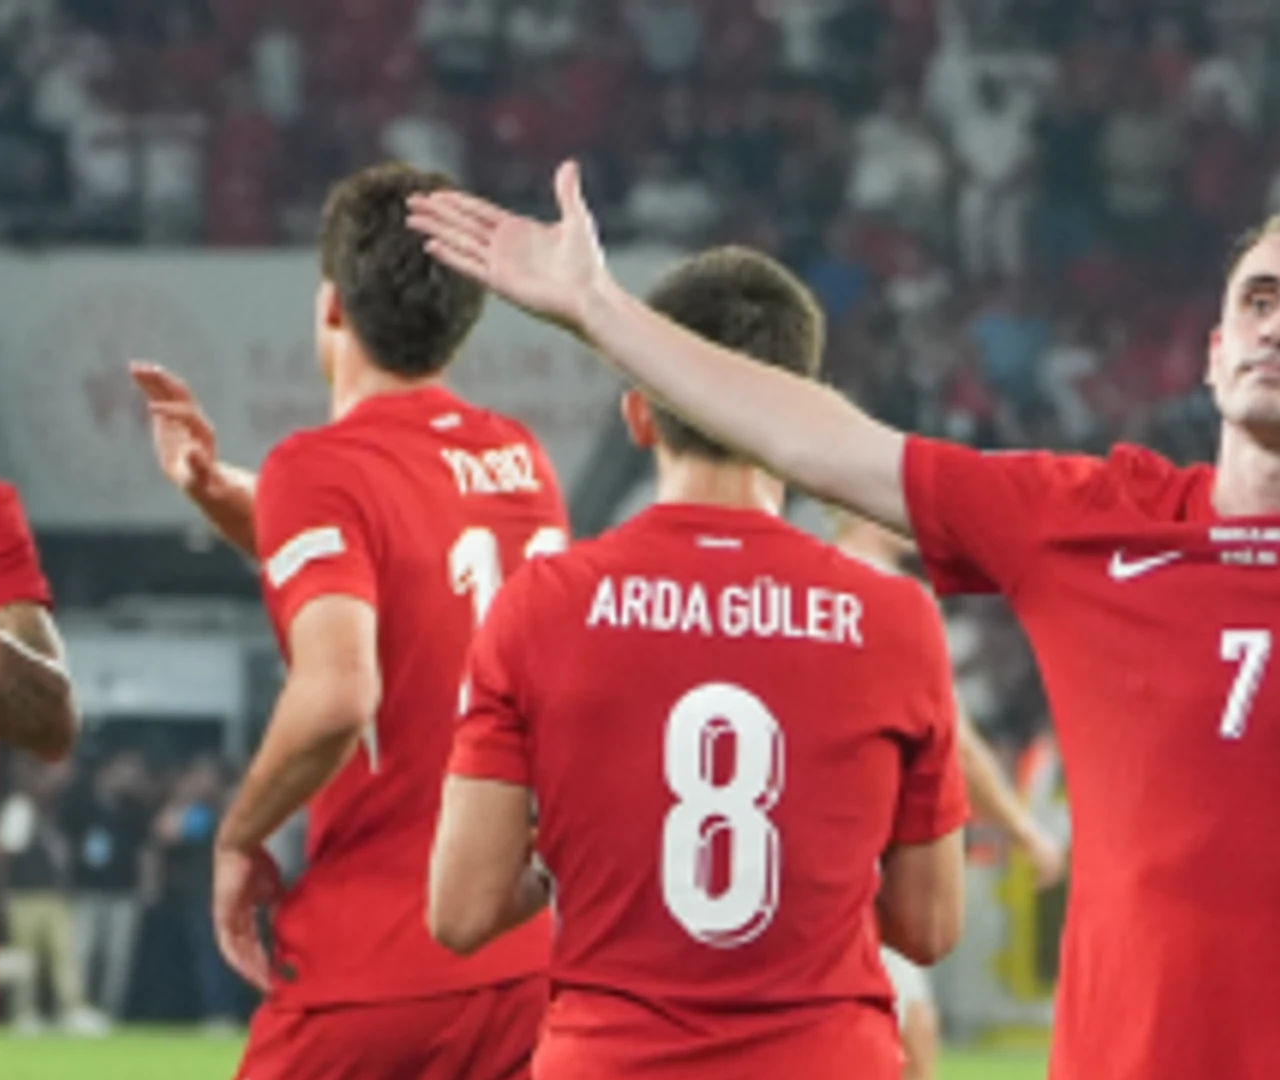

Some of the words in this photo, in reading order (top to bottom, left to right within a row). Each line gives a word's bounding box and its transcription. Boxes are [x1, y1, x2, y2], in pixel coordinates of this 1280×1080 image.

[586, 576, 713, 636] ARDA
[719, 575, 863, 646] GÜLER
[1220, 629, 1271, 738] 7
[660, 682, 785, 947] 8
